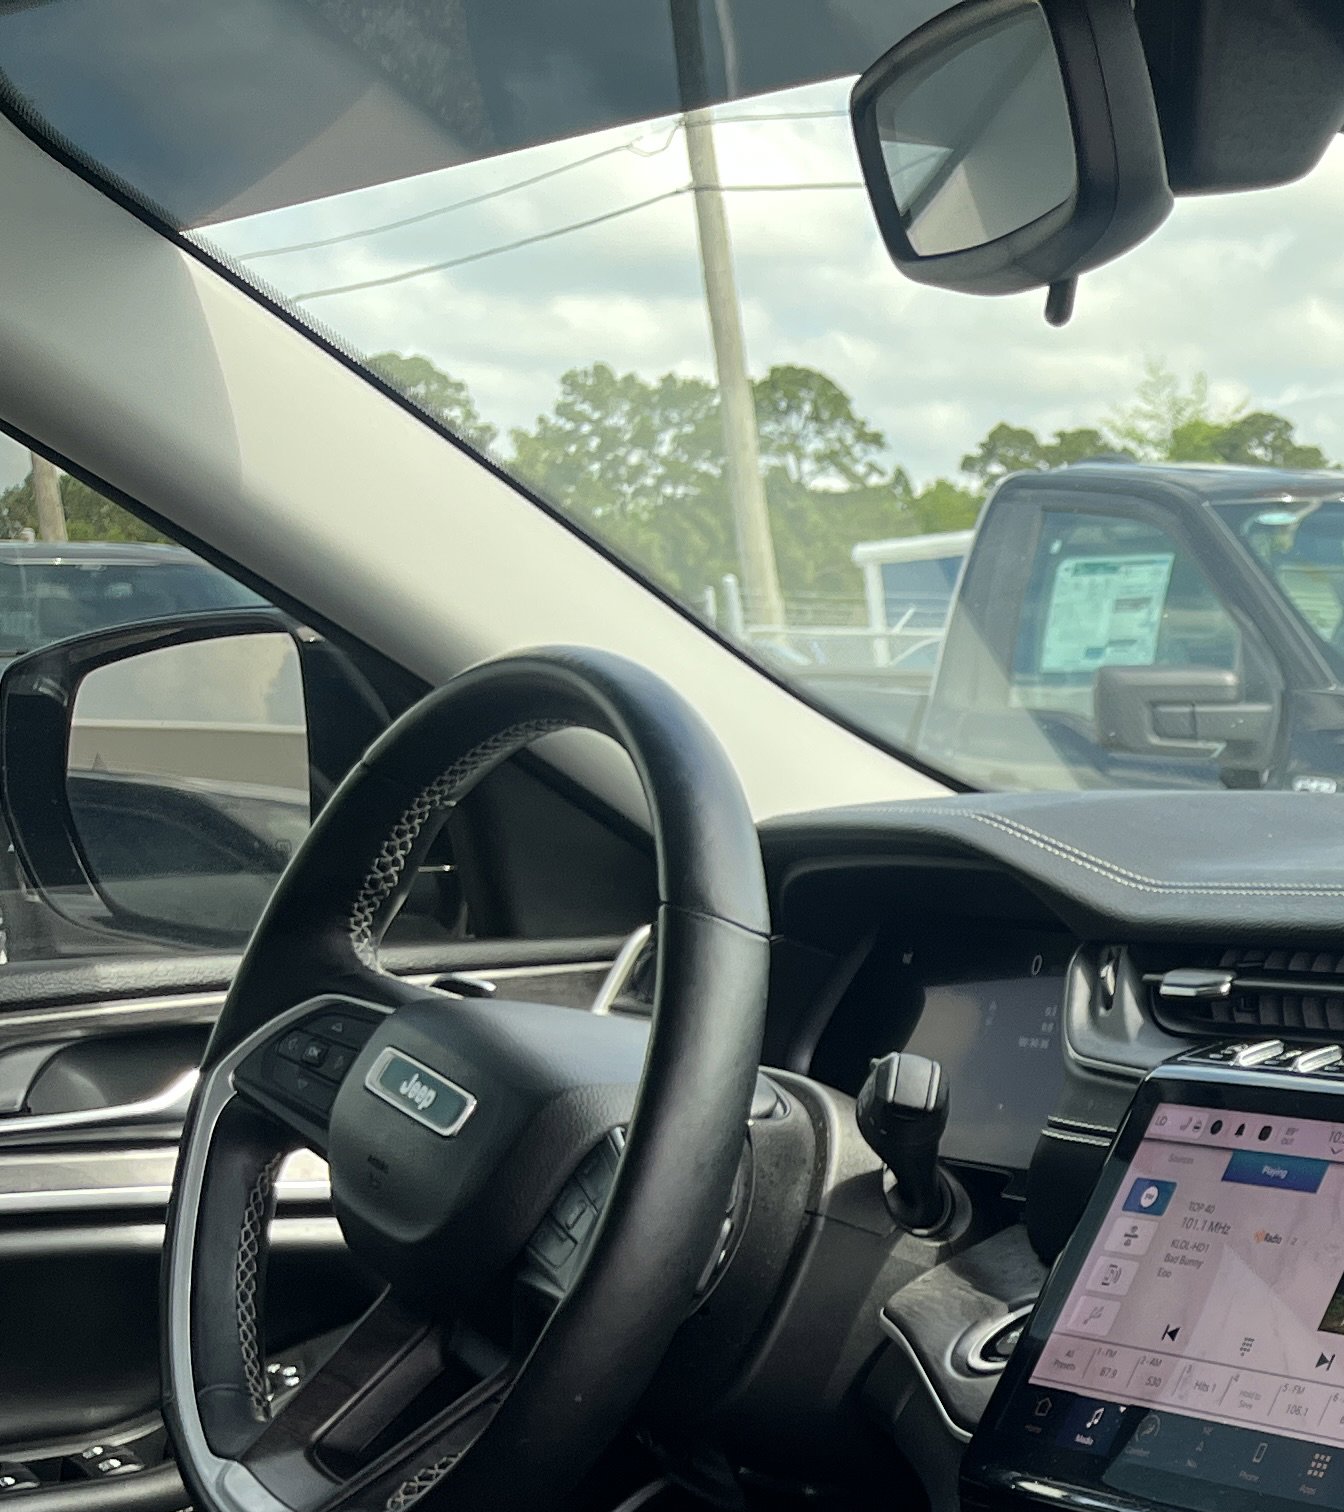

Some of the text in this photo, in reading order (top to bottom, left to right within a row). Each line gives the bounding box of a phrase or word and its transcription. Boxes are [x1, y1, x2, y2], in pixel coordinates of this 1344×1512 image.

[399, 1072, 437, 1111] Jeep
[1261, 1165, 1289, 1179] Playing
[1181, 1216, 1232, 1236] 101.1 MHz
[1163, 1252, 1205, 1270] Bad Bunny
[1291, 1386, 1306, 1395] FM
[1299, 1484, 1317, 1496] Apps
